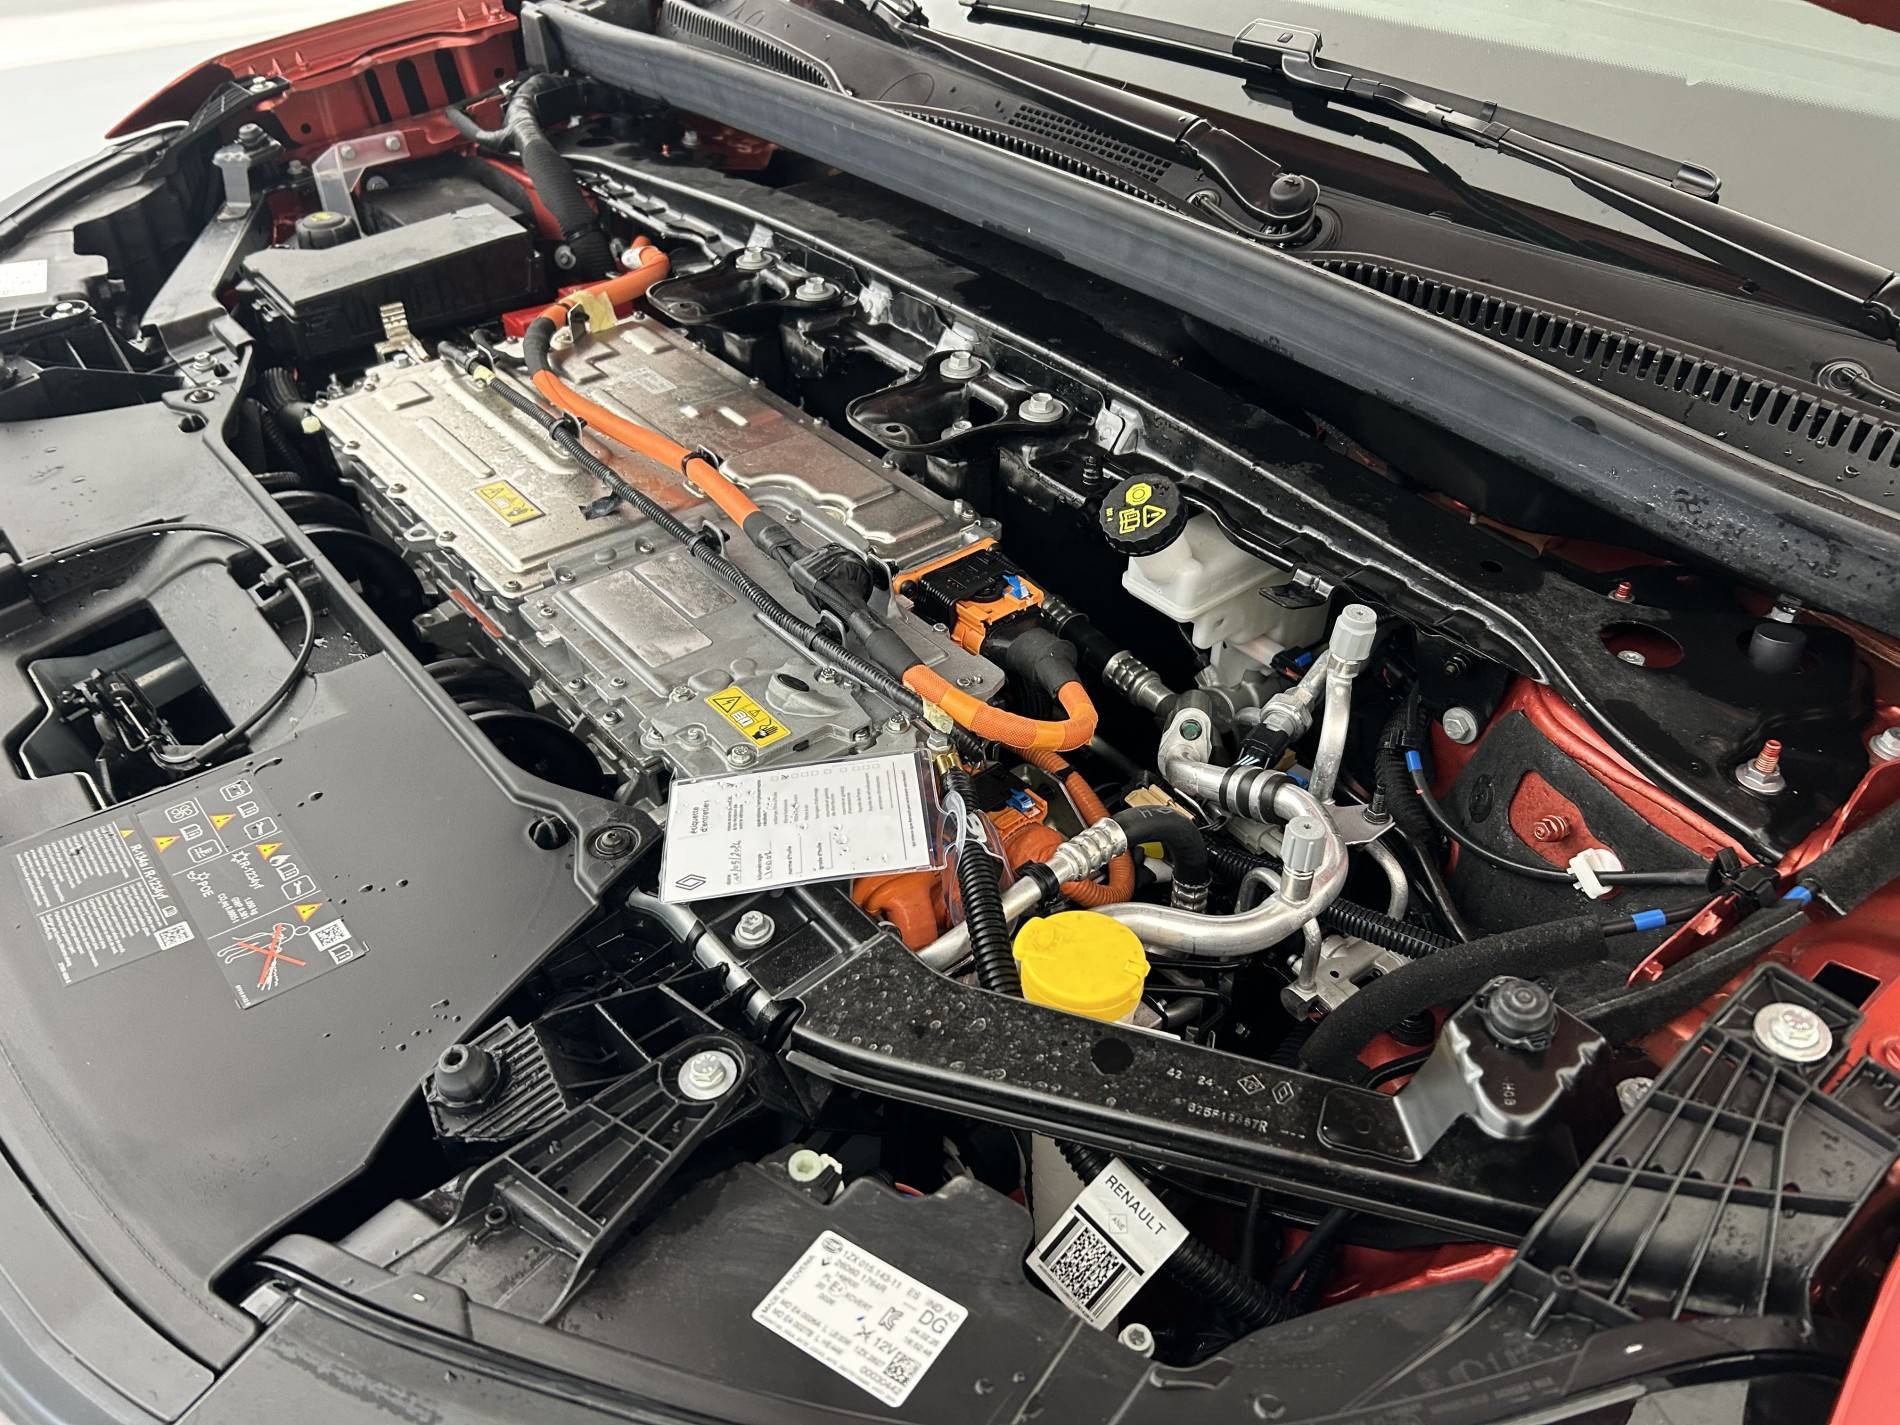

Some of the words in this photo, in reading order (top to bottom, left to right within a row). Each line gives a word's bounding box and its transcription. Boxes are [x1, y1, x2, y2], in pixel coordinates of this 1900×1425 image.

[196, 879, 214, 899] POE
[1166, 1067, 1182, 1079] 42
[1197, 1075, 1213, 1086] 24
[1104, 1174, 1167, 1236] RENAULT
[917, 1309, 950, 1334] DG
[872, 1337, 897, 1356] 12V
